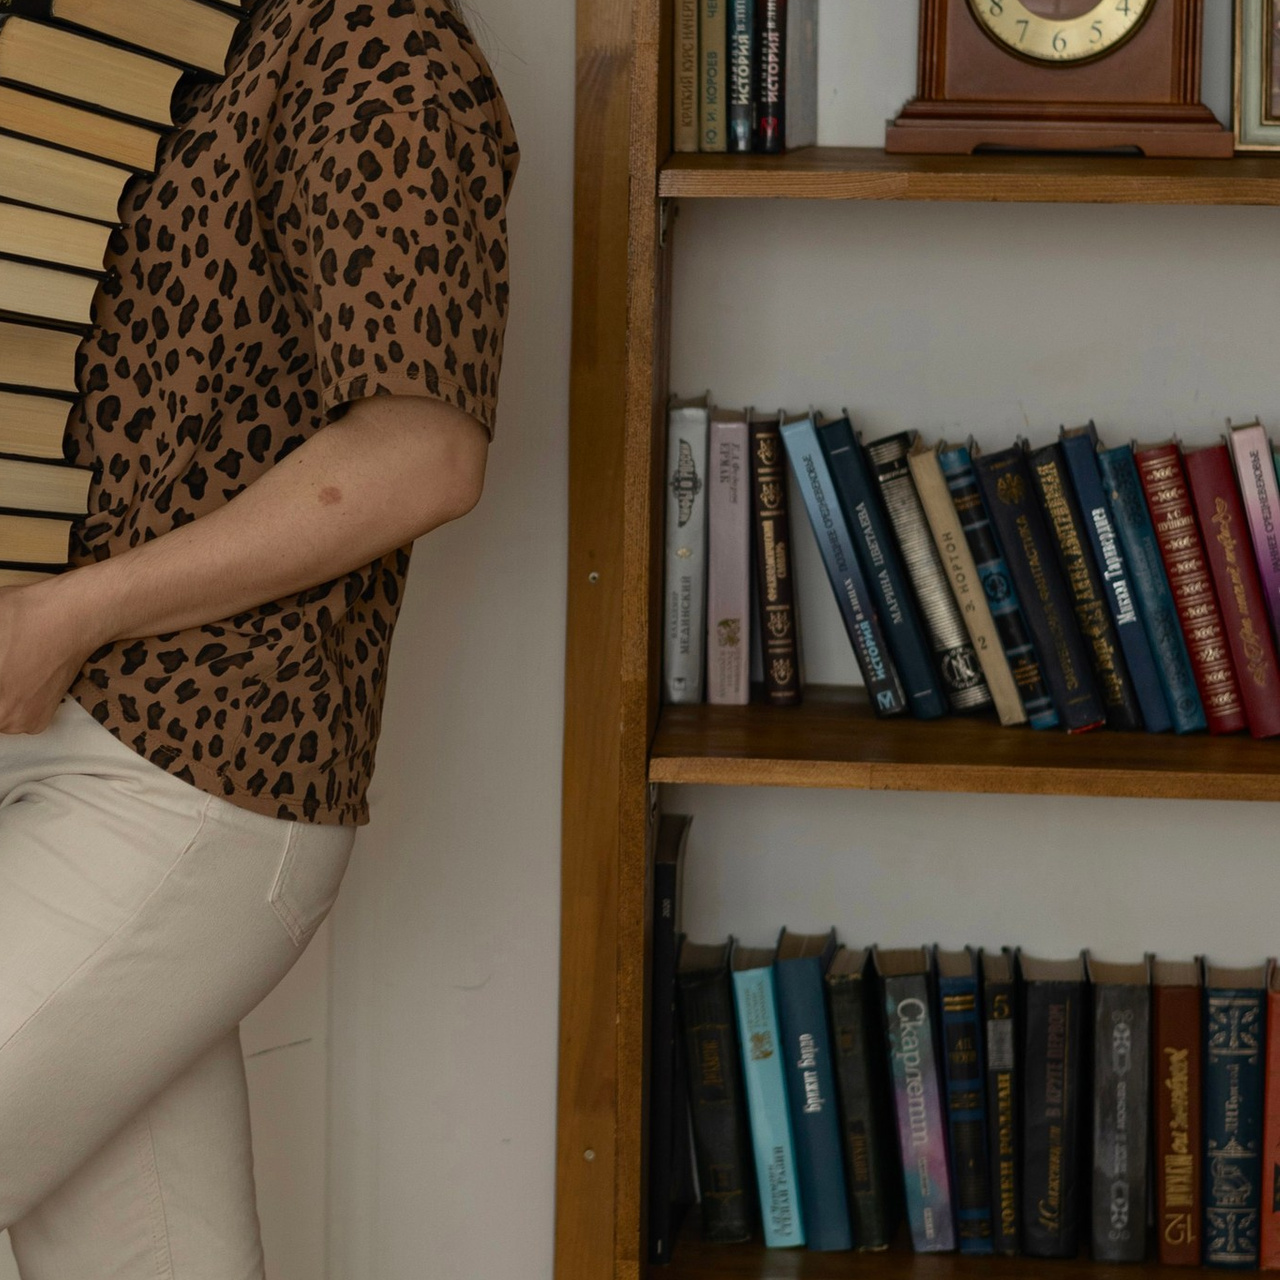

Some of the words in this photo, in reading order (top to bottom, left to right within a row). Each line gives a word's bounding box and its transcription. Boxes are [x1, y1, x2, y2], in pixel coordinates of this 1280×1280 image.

[682, 43, 693, 71] КУРС
[1016, 20, 1029, 43] 7
[1052, 31, 1067, 53] 6
[1088, 20, 1103, 44] 5
[706, 51, 717, 104] КОРОЕВ
[735, 34, 749, 104] ИСТОРИЯ
[766, 31, 780, 102] ИСТОРИЯ
[682, 75, 693, 127] КРАТКИЙ
[853, 499, 885, 567] ЦВЕТАЕВА
[937, 530, 973, 594] НОРТОН
[674, 575, 696, 654] МЕДИНСКИЙ
[876, 568, 904, 624] МАРИНА
[859, 619, 886, 680] ИСТОРИЯ
[977, 635, 988, 651] 2
[992, 994, 1010, 1018] 5
[792, 1031, 819, 1068] Бардо
[888, 996, 942, 1147] Скарлетт
[798, 1068, 826, 1113] Брижит
